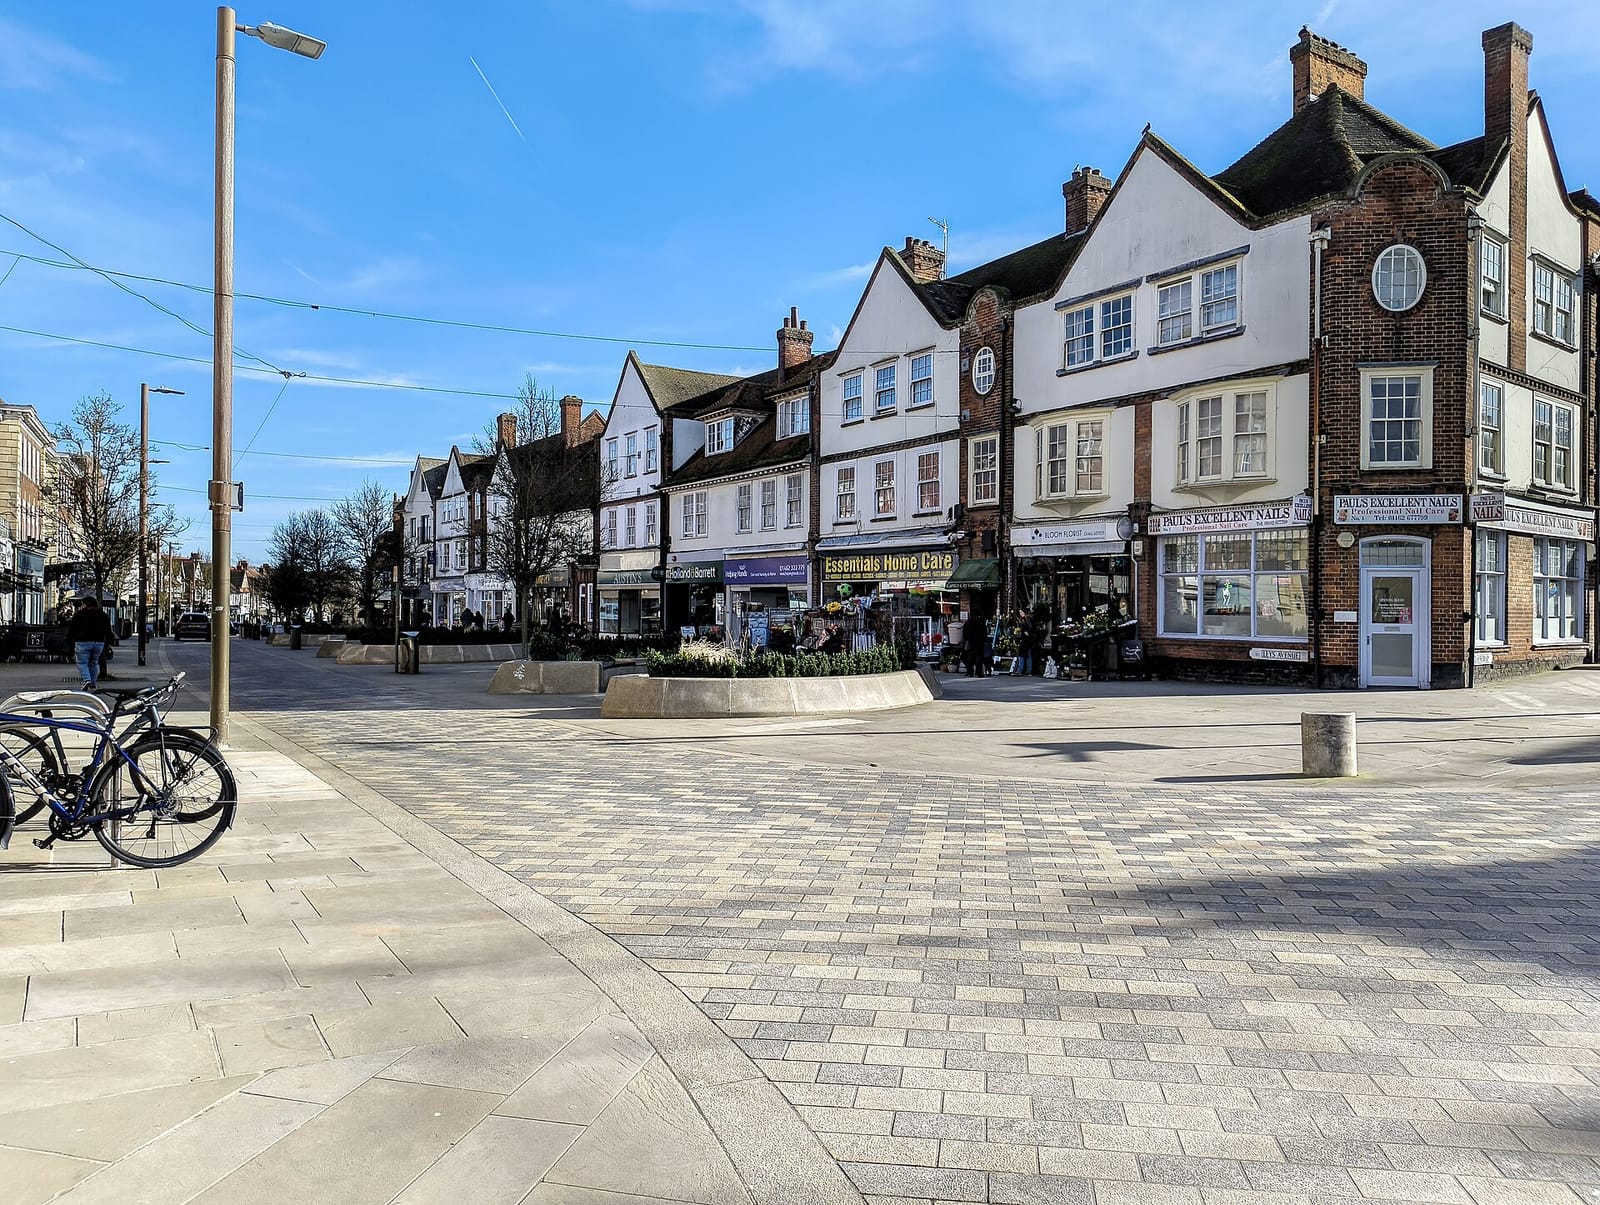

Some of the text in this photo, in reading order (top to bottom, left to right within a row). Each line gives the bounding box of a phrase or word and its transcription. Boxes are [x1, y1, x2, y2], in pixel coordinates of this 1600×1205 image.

[1339, 497, 1458, 508] PAUL'S EXCELLENT NAILS
[1163, 514, 1193, 527] PAUL'S
[1194, 510, 1256, 525] EXCELLENT
[1256, 507, 1290, 521] NAILS
[1293, 507, 1312, 522] NAILS
[1472, 506, 1503, 519] NAILS
[1182, 524, 1218, 532] Professional
[825, 551, 952, 573] Essentials Home Care
[670, 568, 691, 579] Holland
[695, 567, 716, 578] Barrett
